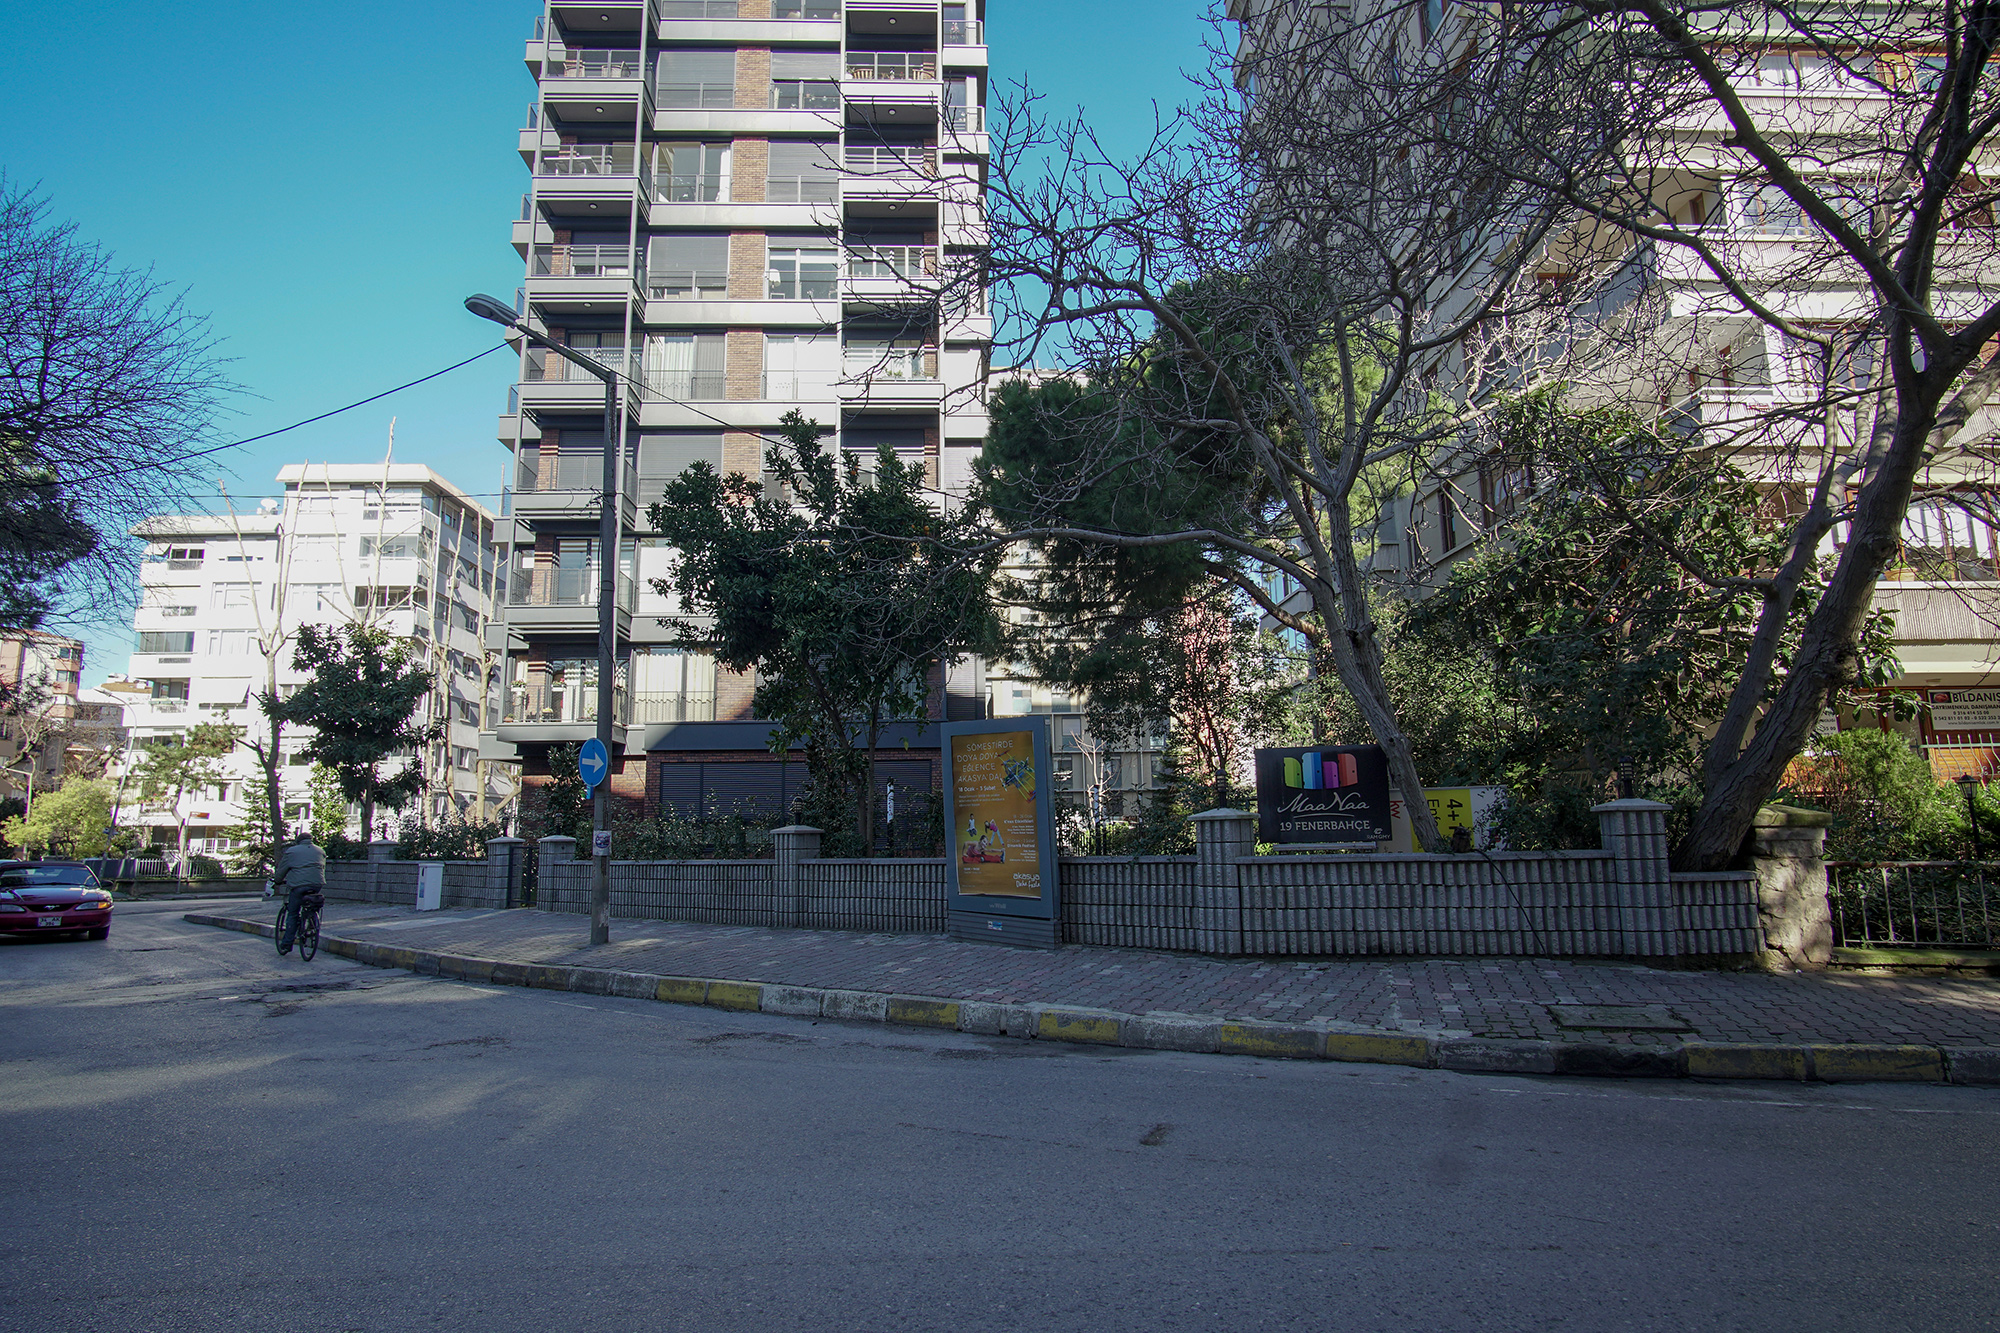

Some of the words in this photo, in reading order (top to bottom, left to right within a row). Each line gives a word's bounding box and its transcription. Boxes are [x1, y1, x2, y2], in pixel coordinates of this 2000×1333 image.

[956, 753, 978, 762] DOYA
[980, 752, 998, 761] DOYA
[962, 763, 996, 772] EĞLENCE
[1280, 822, 1292, 832] 19
[1294, 820, 1371, 832] FENERBAHÇE
[1013, 872, 1041, 882] akasya
